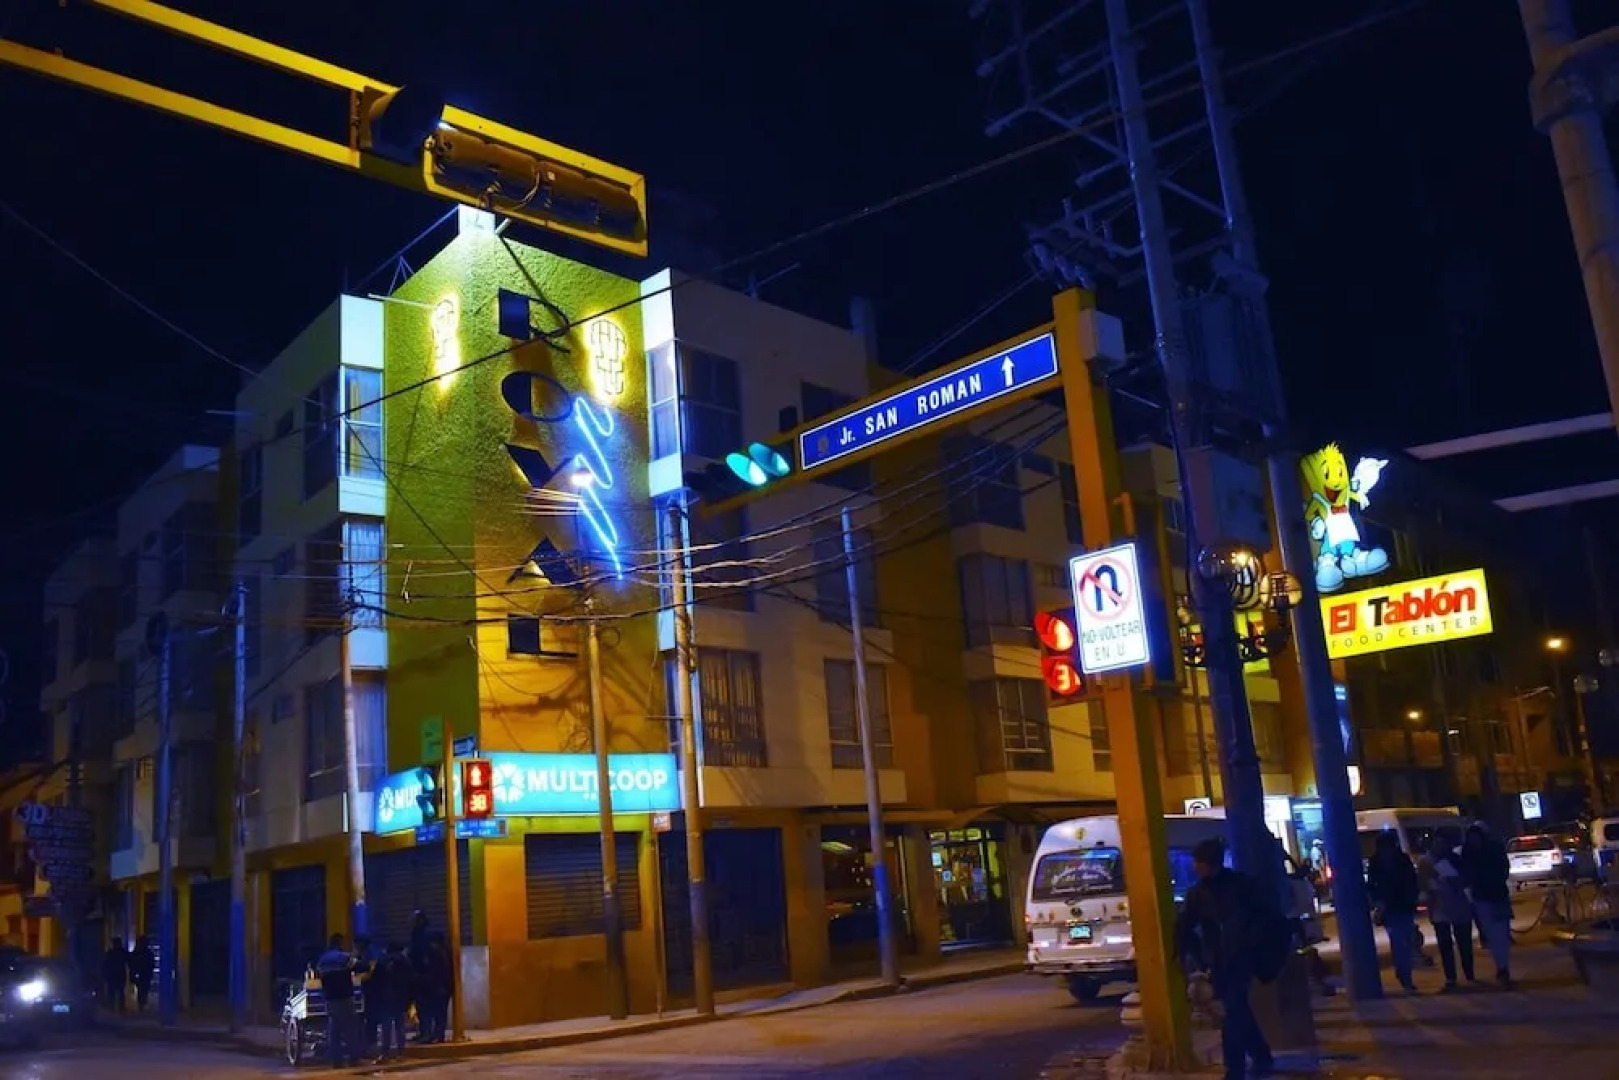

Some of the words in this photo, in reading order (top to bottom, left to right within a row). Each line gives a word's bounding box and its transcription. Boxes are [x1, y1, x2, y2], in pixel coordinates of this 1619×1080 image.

[839, 426, 856, 446] Jr.
[865, 407, 898, 436] SAN
[917, 373, 982, 415] ROMAN
[1368, 580, 1476, 627] Tablón
[1098, 620, 1140, 641] VOLTEAR
[1332, 633, 1383, 649] FOOD
[1398, 616, 1478, 638] CENTER
[1094, 645, 1110, 662] EN
[1117, 640, 1126, 657] U
